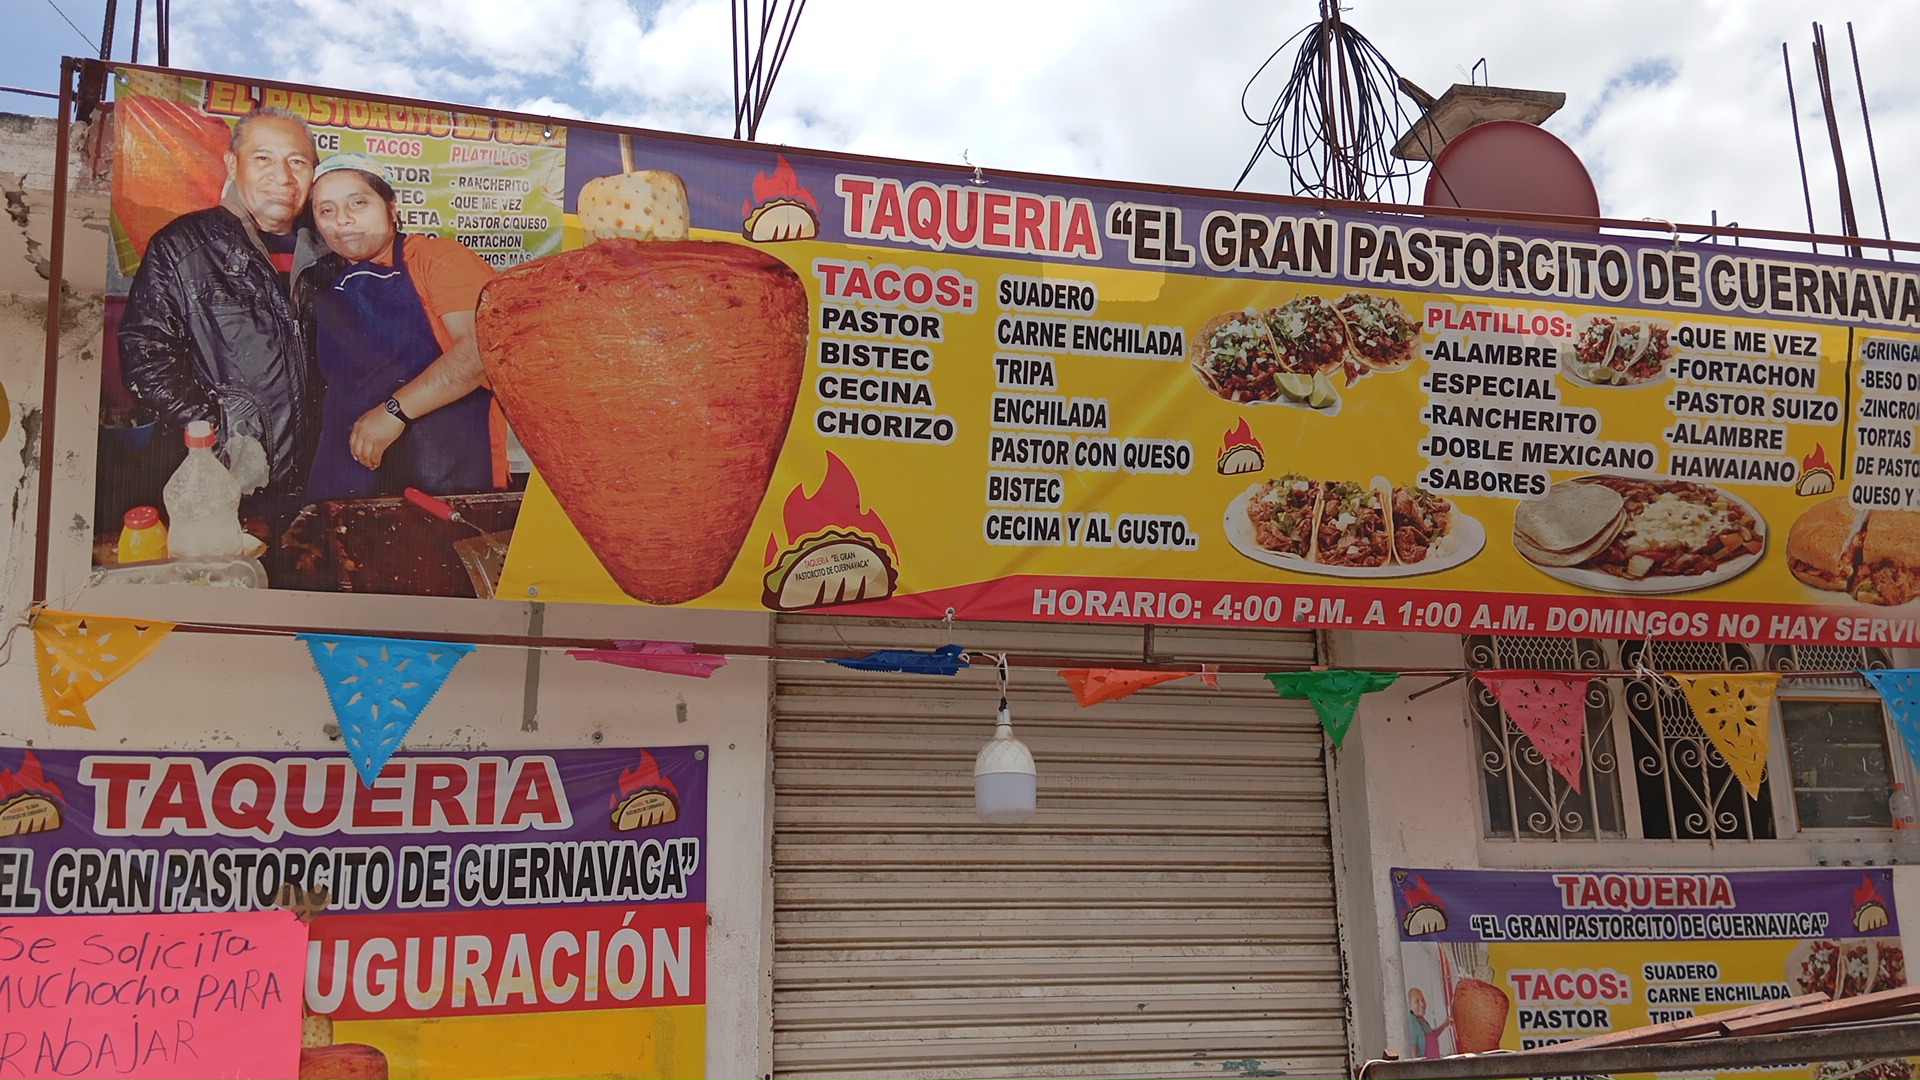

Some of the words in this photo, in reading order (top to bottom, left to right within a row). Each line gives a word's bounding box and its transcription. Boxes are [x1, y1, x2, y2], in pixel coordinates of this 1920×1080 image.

[207, 80, 254, 114] EL
[452, 113, 492, 141] DE
[366, 138, 421, 157] TACOS
[451, 146, 528, 168] PLATILLOS
[458, 177, 530, 192] RANCHERITO
[482, 198, 498, 211] ME
[502, 199, 522, 211] VEZ
[457, 216, 500, 230] PASTOR
[457, 235, 522, 248] FORTACHON
[841, 178, 1100, 256] TAQUERIA
[1205, 215, 1332, 275] GRAN
[1349, 226, 1629, 299] PASTORCITO
[1642, 252, 1697, 303] DE
[1710, 259, 1920, 323] CUERNAVA
[817, 263, 973, 309] TACOS:
[999, 279, 1094, 311] SUADERO
[822, 308, 941, 338] PASTOR
[1427, 307, 1573, 338] PLATILLOS:
[998, 319, 1067, 349] CARNE
[1072, 325, 1183, 357] ENCHILADA
[1670, 325, 1726, 351] -QUE
[1733, 330, 1766, 354] ME
[1773, 333, 1817, 357] VEZ
[820, 342, 930, 372] BISTEC
[1425, 339, 1558, 369] -ALAMBRE
[996, 358, 1055, 387] TRIPA
[1423, 371, 1557, 401] -ESPECIAL
[1669, 358, 1816, 389] -FORTACHON
[1861, 370, 1903, 391] -BESO
[1907, 373, 1920, 391] D
[818, 376, 932, 406] CECINA
[1668, 390, 1765, 418] -PASTOR
[1772, 396, 1839, 422] SUIZO
[816, 411, 954, 441] CHORIZO
[993, 397, 1107, 429] ENCHILADA
[1424, 403, 1598, 435] -RANCHERITO
[1666, 423, 1783, 450] -ALAMBRE
[1858, 427, 1911, 449] TORTAS
[991, 437, 1069, 466] PASTOR
[1075, 442, 1117, 467] CON
[1123, 443, 1190, 470] QUESO
[1421, 436, 1513, 462] -DOBLE
[1521, 441, 1655, 470] MEXICANO
[1671, 454, 1796, 482] HAWAIANO
[1855, 456, 1875, 475] DE
[1878, 457, 1920, 478] PASTO
[988, 476, 1061, 504] BISTEC
[1420, 467, 1546, 495] -SABORES
[1852, 485, 1901, 506] QUESO
[1905, 488, 1914, 506] Y
[986, 515, 1060, 542] CECINA
[1067, 517, 1081, 542] Y
[1086, 518, 1112, 543] AL
[1118, 519, 1196, 546] GUSTO..
[840, 551, 856, 561] GRAN
[826, 567, 834, 576] DE
[1032, 588, 1202, 620] HORARIO:
[1212, 593, 1283, 622] 4:00
[1293, 597, 1353, 624] P.M.
[1363, 599, 1386, 626] A
[1399, 601, 1463, 628] 1:00
[1470, 604, 1535, 631] A.M.
[1546, 607, 1709, 637] DOMINGOS
[1717, 613, 1760, 639] NO
[1768, 615, 1829, 640] HAY
[91, 761, 562, 836] TAQUERIA
[50, 853, 155, 908] GRAN
[164, 852, 390, 908] PASTORCITO
[401, 849, 449, 903] DE
[1556, 876, 1732, 909] TAQUERIA
[1507, 916, 1559, 938] GRAN
[1566, 915, 1676, 938] PASTORCITO
[1681, 915, 1704, 937] DE
[0, 925, 56, 964] Se
[1510, 973, 1629, 1001] TACOS:
[1644, 964, 1718, 980] SUADERO
[192, 969, 282, 1018] PARA
[1647, 987, 1700, 1003] CARNE
[1705, 985, 1791, 1002] ENCHILADA
[1519, 1010, 1609, 1029] PASTOR
